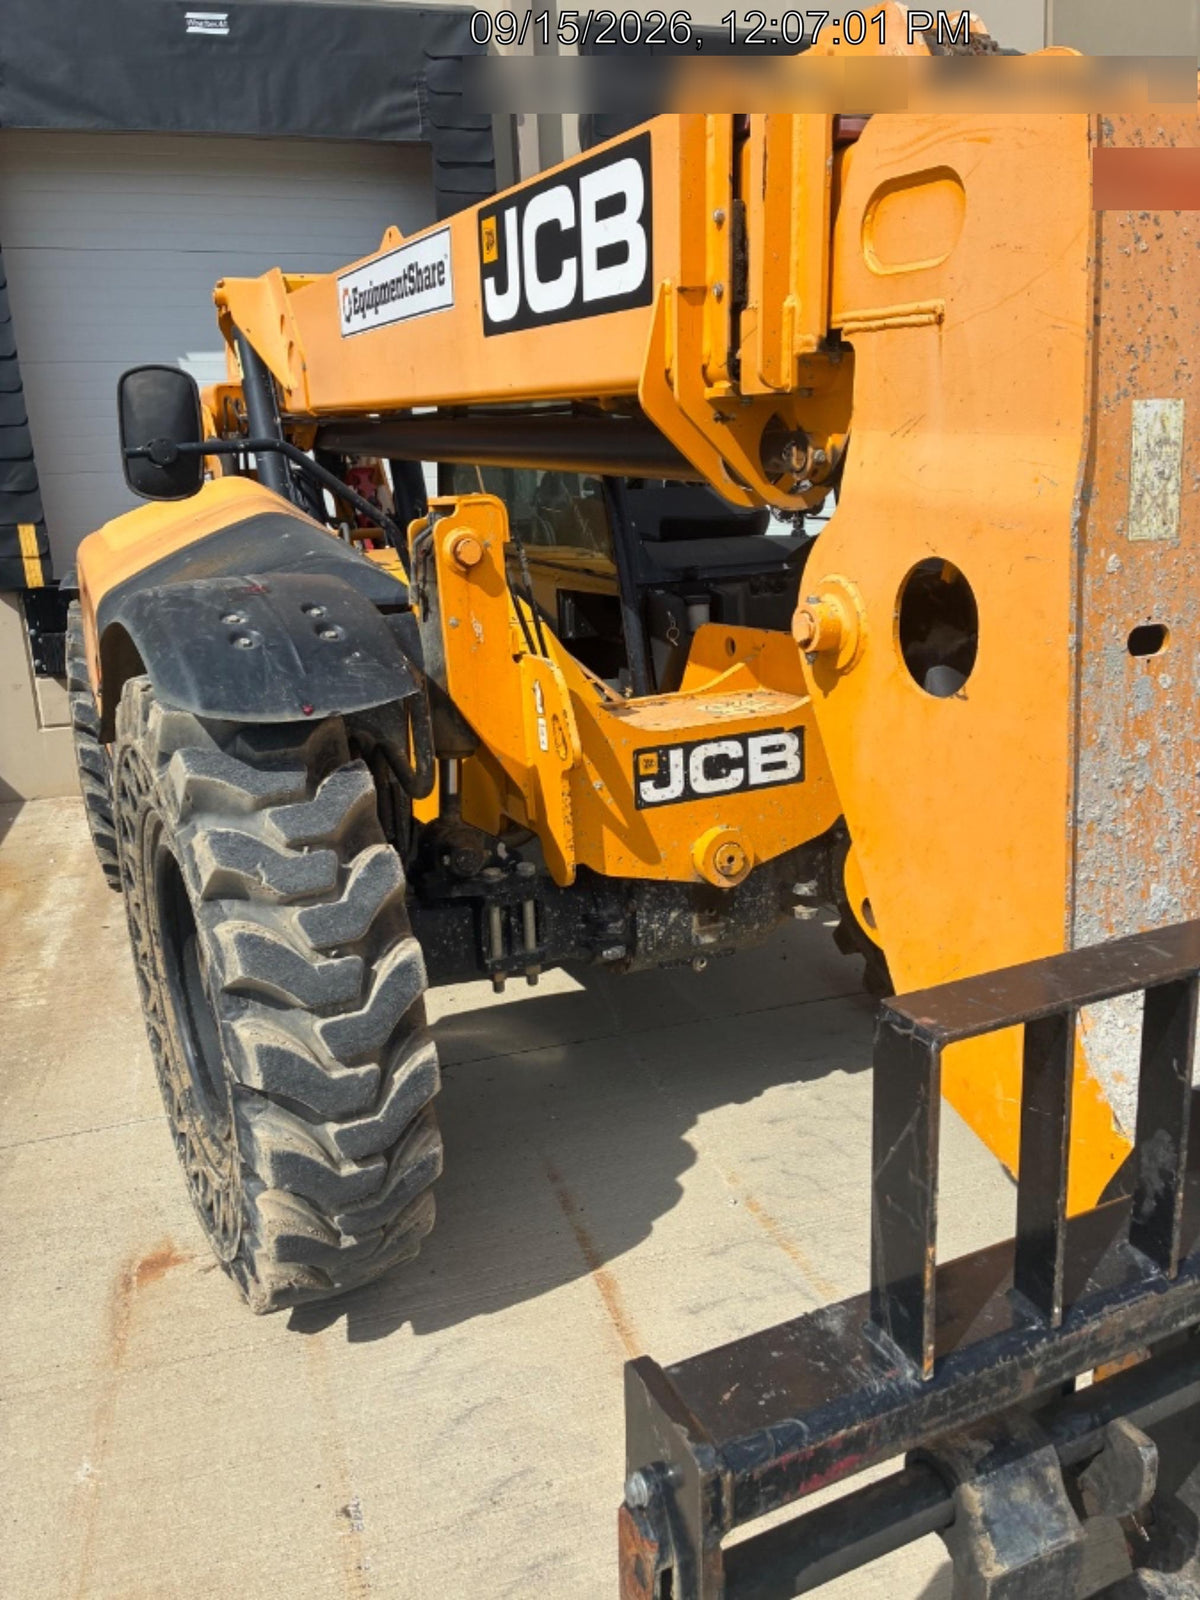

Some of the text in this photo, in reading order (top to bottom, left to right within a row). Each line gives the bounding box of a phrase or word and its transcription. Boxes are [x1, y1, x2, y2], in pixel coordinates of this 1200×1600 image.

[484, 157, 647, 323] JCB
[351, 260, 446, 319] EquipmentShare
[639, 732, 801, 803] JCB
